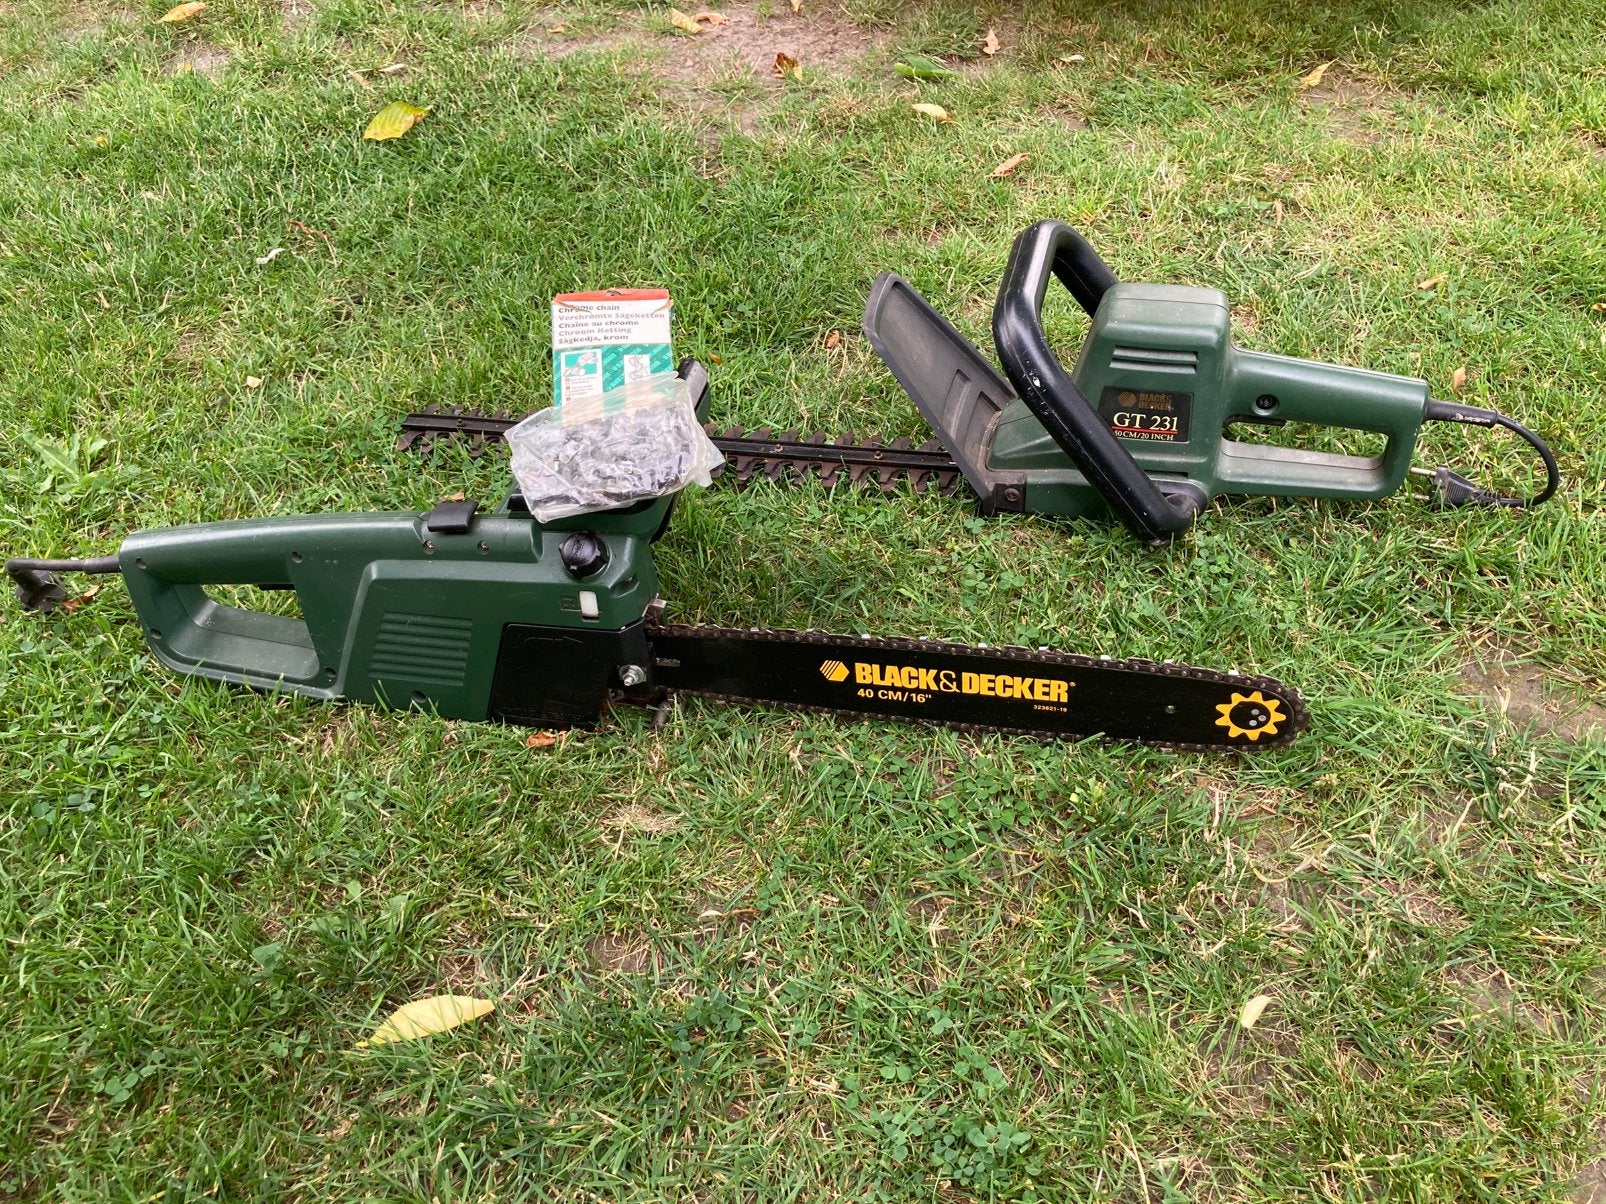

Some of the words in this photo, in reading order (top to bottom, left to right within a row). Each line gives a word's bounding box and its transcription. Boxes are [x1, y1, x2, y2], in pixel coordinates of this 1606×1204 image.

[558, 329, 595, 337] Chroom
[597, 327, 632, 335] Ketting
[1113, 412, 1146, 428] GT
[1149, 416, 1179, 431] 231
[1151, 433, 1174, 441] INCH
[857, 688, 874, 699] 40
[878, 690, 933, 703] CM/16"
